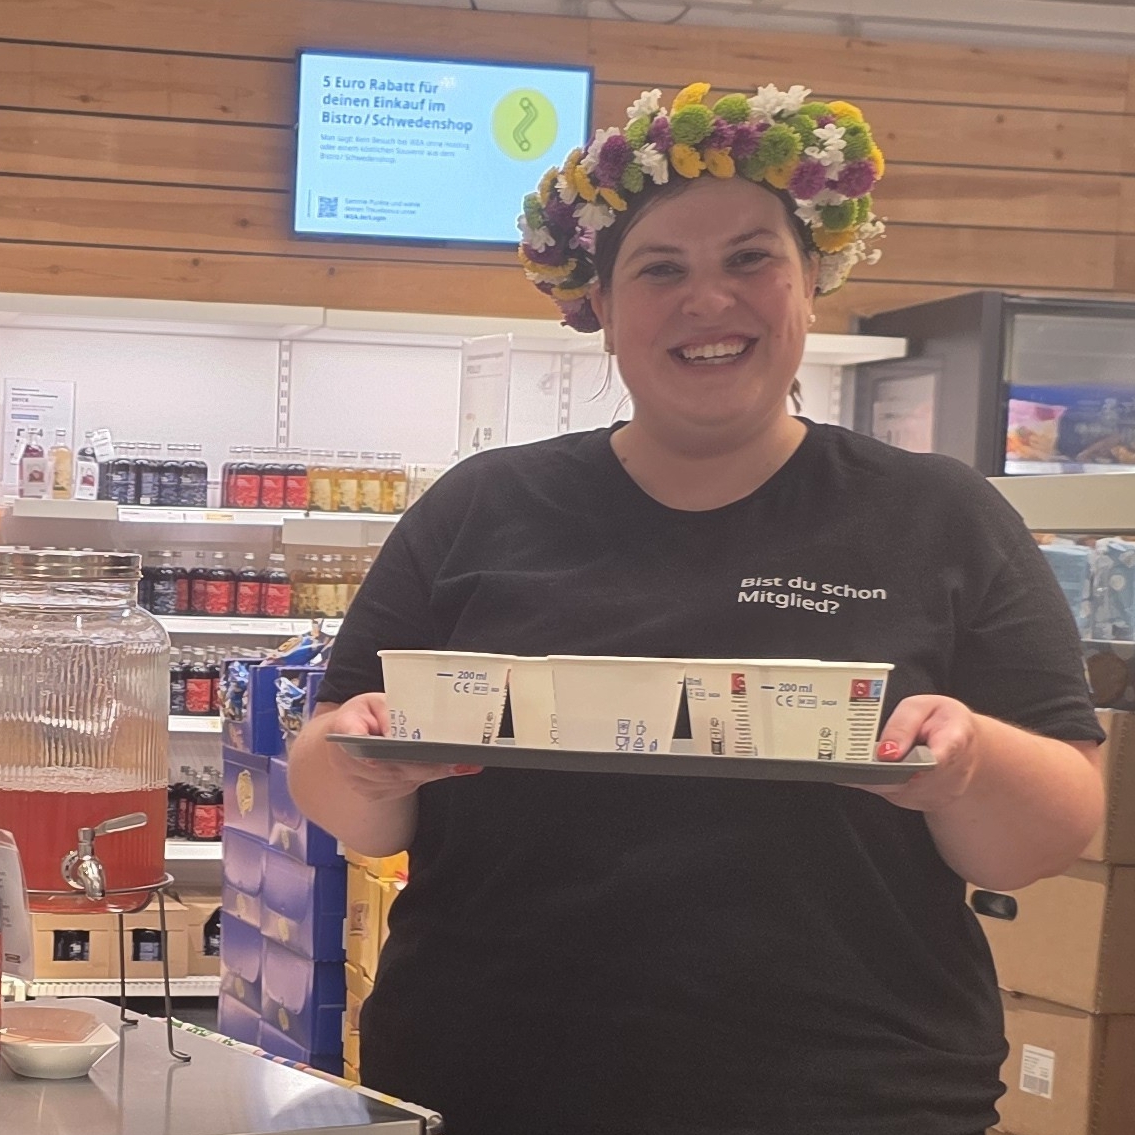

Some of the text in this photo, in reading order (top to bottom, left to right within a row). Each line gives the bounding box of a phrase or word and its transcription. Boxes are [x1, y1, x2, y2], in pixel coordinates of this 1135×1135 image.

[323, 76, 439, 94] 5 Euro Rabatt für
[322, 93, 446, 112] deinen Einkauf im
[321, 111, 363, 124] Bistro
[371, 113, 473, 135] Schwedenshop
[741, 576, 888, 600] Bist du schon
[737, 590, 841, 615] Mitglied?
[457, 670, 487, 681] 200 ml
[778, 683, 813, 693] 200 ml
